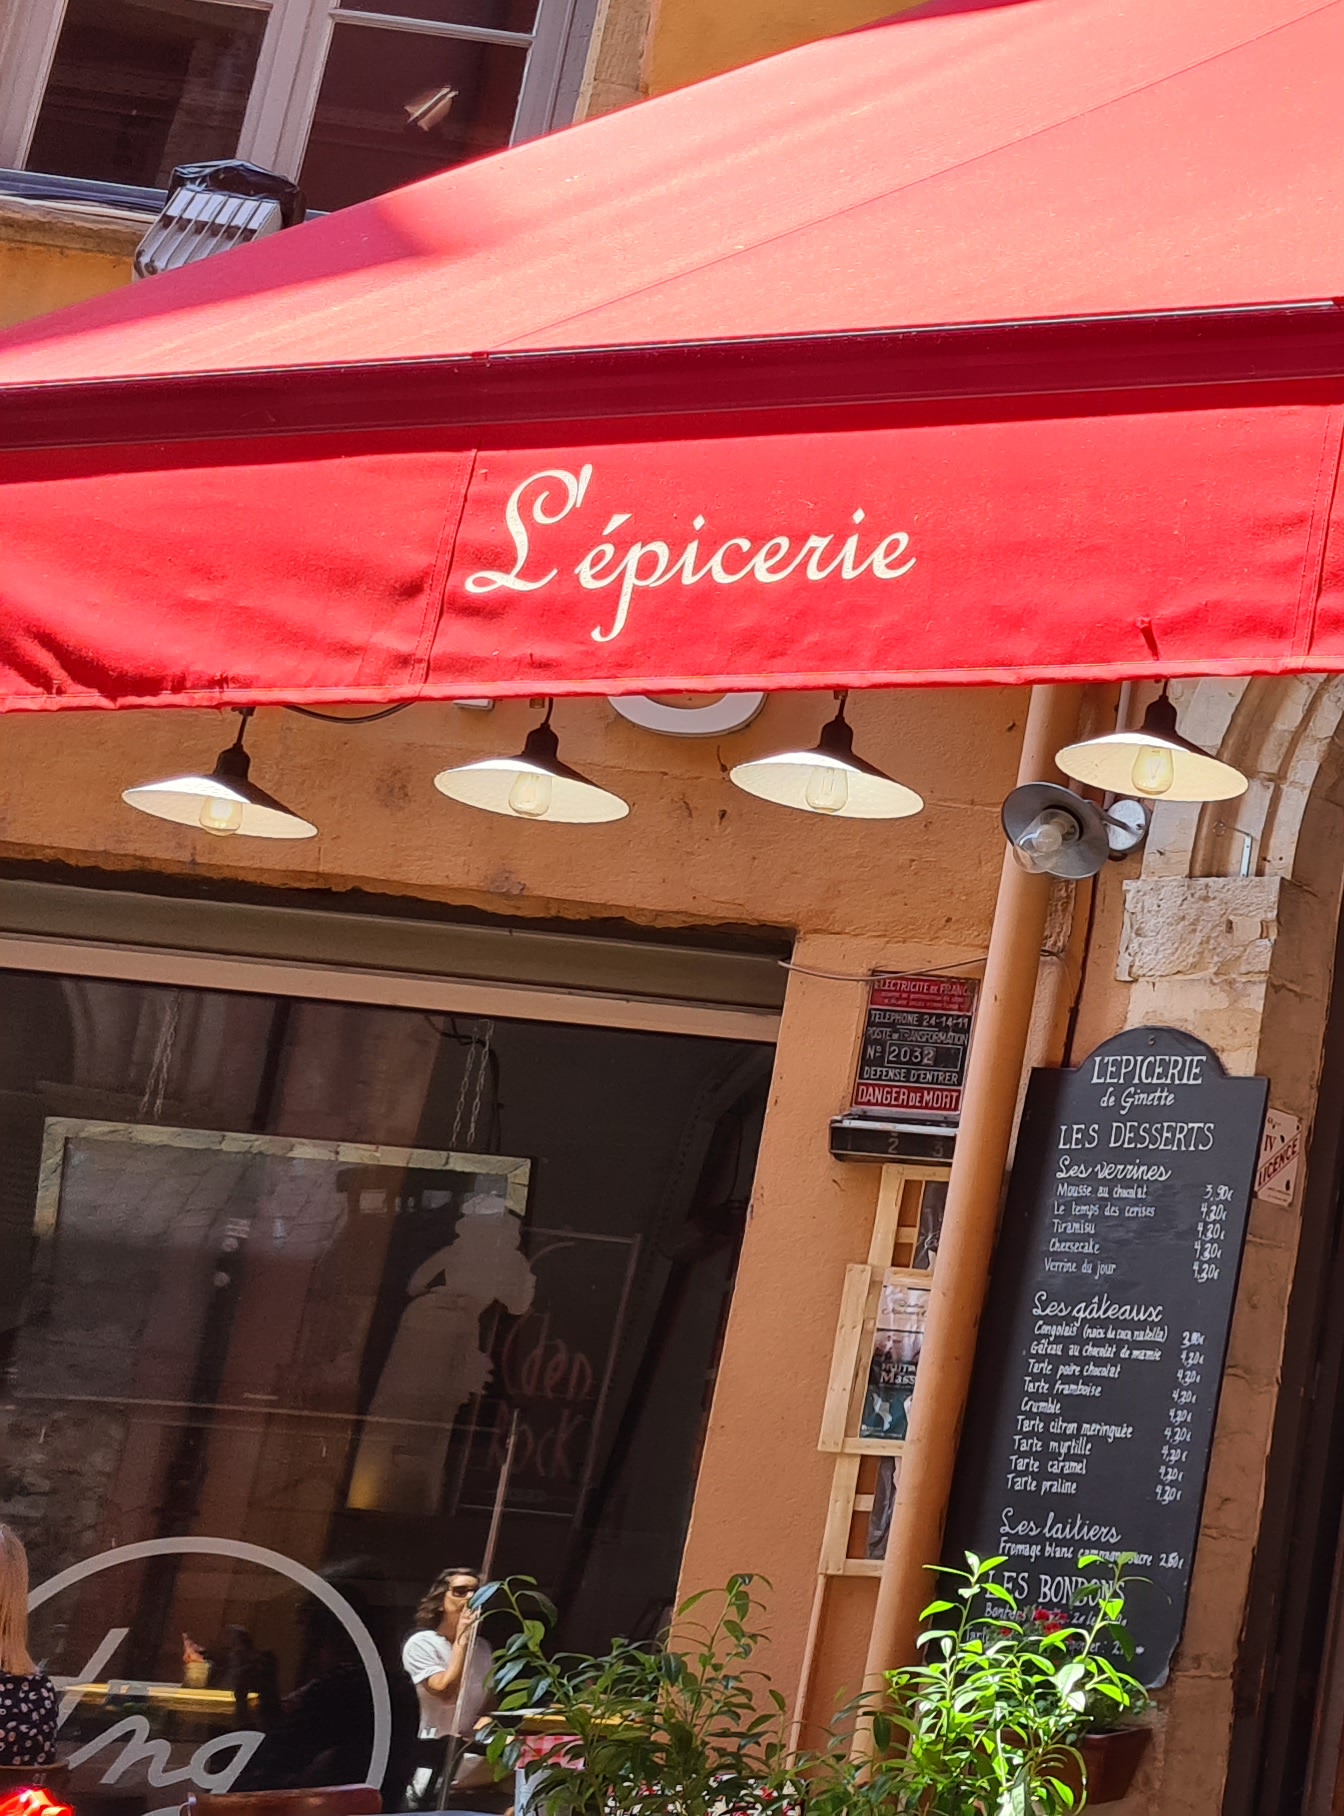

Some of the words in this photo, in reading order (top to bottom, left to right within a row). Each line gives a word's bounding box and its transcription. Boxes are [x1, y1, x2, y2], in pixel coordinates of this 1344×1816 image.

[464, 463, 917, 643] L'épicerie
[939, 983, 970, 996] FRANC
[871, 1011, 919, 1026] TELEPHONE
[888, 1046, 935, 1065] 2032
[863, 1066, 906, 1082] DEFENSE
[911, 1070, 959, 1085] D'ENTRER
[1091, 1055, 1207, 1085] L'EPICERIE
[858, 1085, 908, 1106] DANGER
[909, 1093, 922, 1106] DE
[923, 1091, 959, 1109] MORT
[1100, 1087, 1115, 1107] de
[1120, 1087, 1175, 1115] Ginette
[888, 1138, 899, 1154] 2
[1058, 1123, 1099, 1149] LES
[1109, 1122, 1214, 1151] DESSERTS
[1264, 1134, 1277, 1152] IV
[1056, 1155, 1092, 1179] Les
[1095, 1159, 1171, 1181] verrines
[1258, 1138, 1298, 1187] LICENCE
[1057, 1183, 1091, 1197] Mousse
[1113, 1184, 1147, 1199] chocolat
[1054, 1202, 1065, 1215] Le
[1071, 1203, 1099, 1218] temps
[1104, 1203, 1119, 1217] des
[1125, 1204, 1155, 1218] cerises
[1052, 1220, 1095, 1234] Tiramisu
[1049, 1239, 1100, 1254] Cheesecake
[1044, 1257, 1077, 1272] Verrine
[1081, 1259, 1092, 1274] du
[1095, 1261, 1116, 1280] jour
[1032, 1291, 1071, 1316] Les
[1071, 1293, 1163, 1327] gâteaux
[1034, 1320, 1077, 1341] Congolais
[1030, 1339, 1062, 1355] Gâteau
[1082, 1341, 1116, 1358] chocolat
[1120, 1345, 1130, 1358] de
[880, 1371, 916, 1385] Mass
[1028, 1359, 1052, 1374] Tarte
[1056, 1363, 1081, 1379] poire
[1083, 1360, 1121, 1378] chocolat
[1023, 1377, 1049, 1394] Tarte
[1053, 1379, 1102, 1397] framboise
[1020, 1397, 1062, 1415] Crumble
[1016, 1415, 1044, 1433] Tarte
[1050, 1417, 1078, 1435] citron
[1012, 1435, 1043, 1452] Tarte
[1049, 1437, 1092, 1460] myrtille
[1009, 1455, 1040, 1473] Tarte
[1047, 1458, 1087, 1475] caramel
[1006, 1473, 1037, 1491] Tarte
[1040, 1477, 1077, 1496] praline
[1000, 1507, 1043, 1536] Les
[1043, 1511, 1122, 1545] laitiers
[998, 1537, 1042, 1563] Fromage
[1044, 1541, 1074, 1559] blanc
[985, 1570, 1029, 1600] LES
